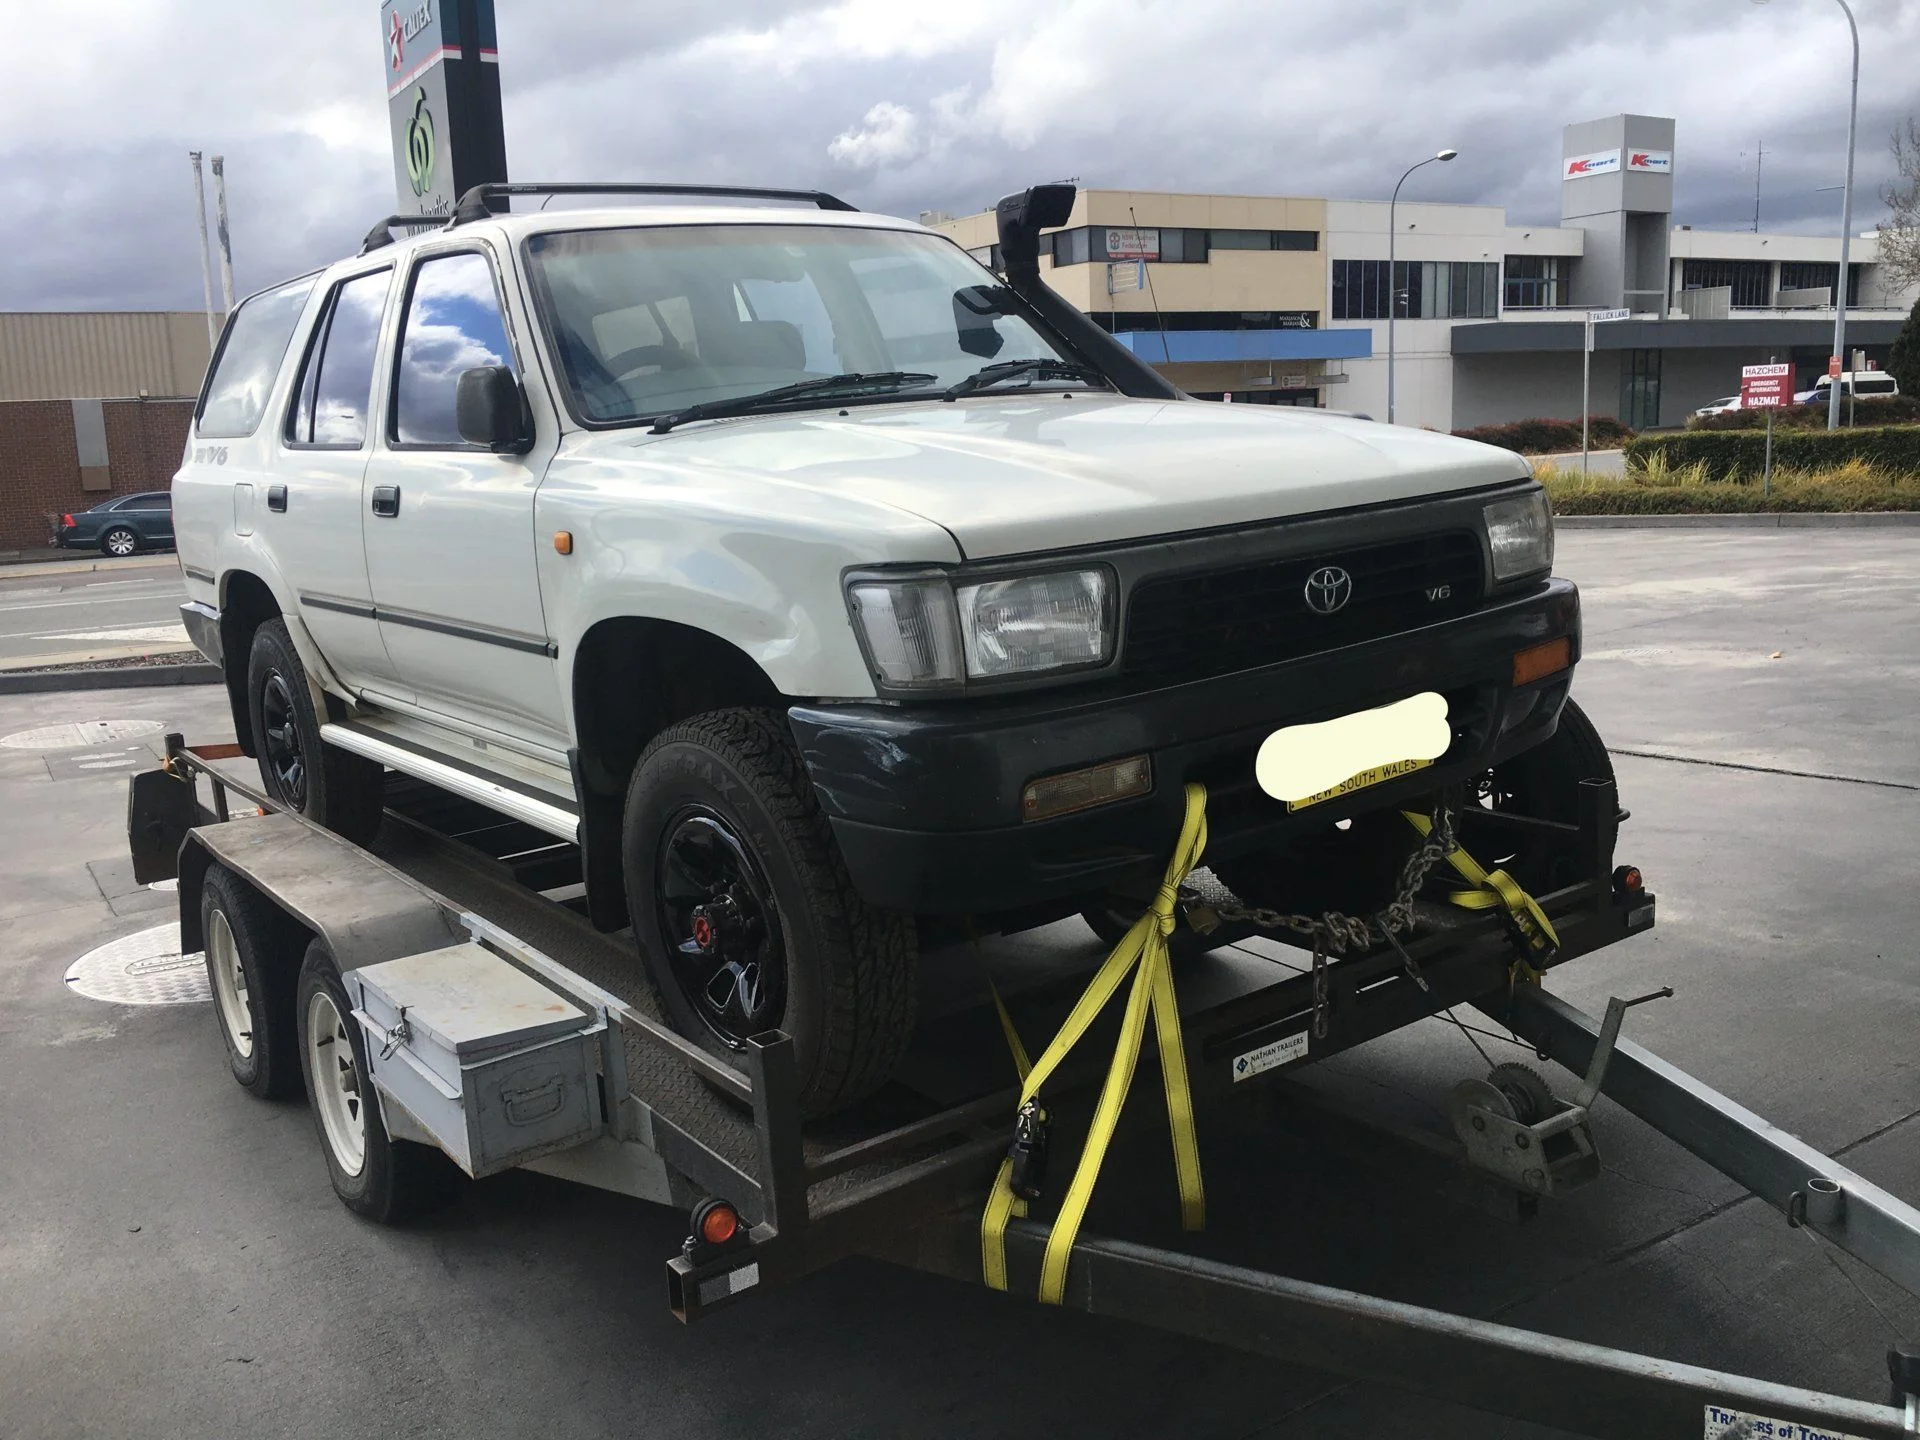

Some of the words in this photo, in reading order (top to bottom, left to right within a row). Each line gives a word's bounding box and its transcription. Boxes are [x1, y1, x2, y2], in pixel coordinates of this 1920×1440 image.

[1568, 158, 1617, 175] Kmart
[1631, 153, 1669, 167] Kmart
[1615, 309, 1629, 318] LANE
[1745, 366, 1786, 376] HAZCHEM
[1750, 379, 1779, 387] EMERGENCY
[1748, 396, 1781, 406] HAZMAT
[1425, 584, 1451, 602] V6
[1339, 771, 1376, 792] SOUTH
[1382, 759, 1417, 778] WALES
[1250, 1046, 1276, 1062] NATHAN
[1277, 1036, 1304, 1052] TRAILERS
[1778, 1425, 1793, 1439] of
